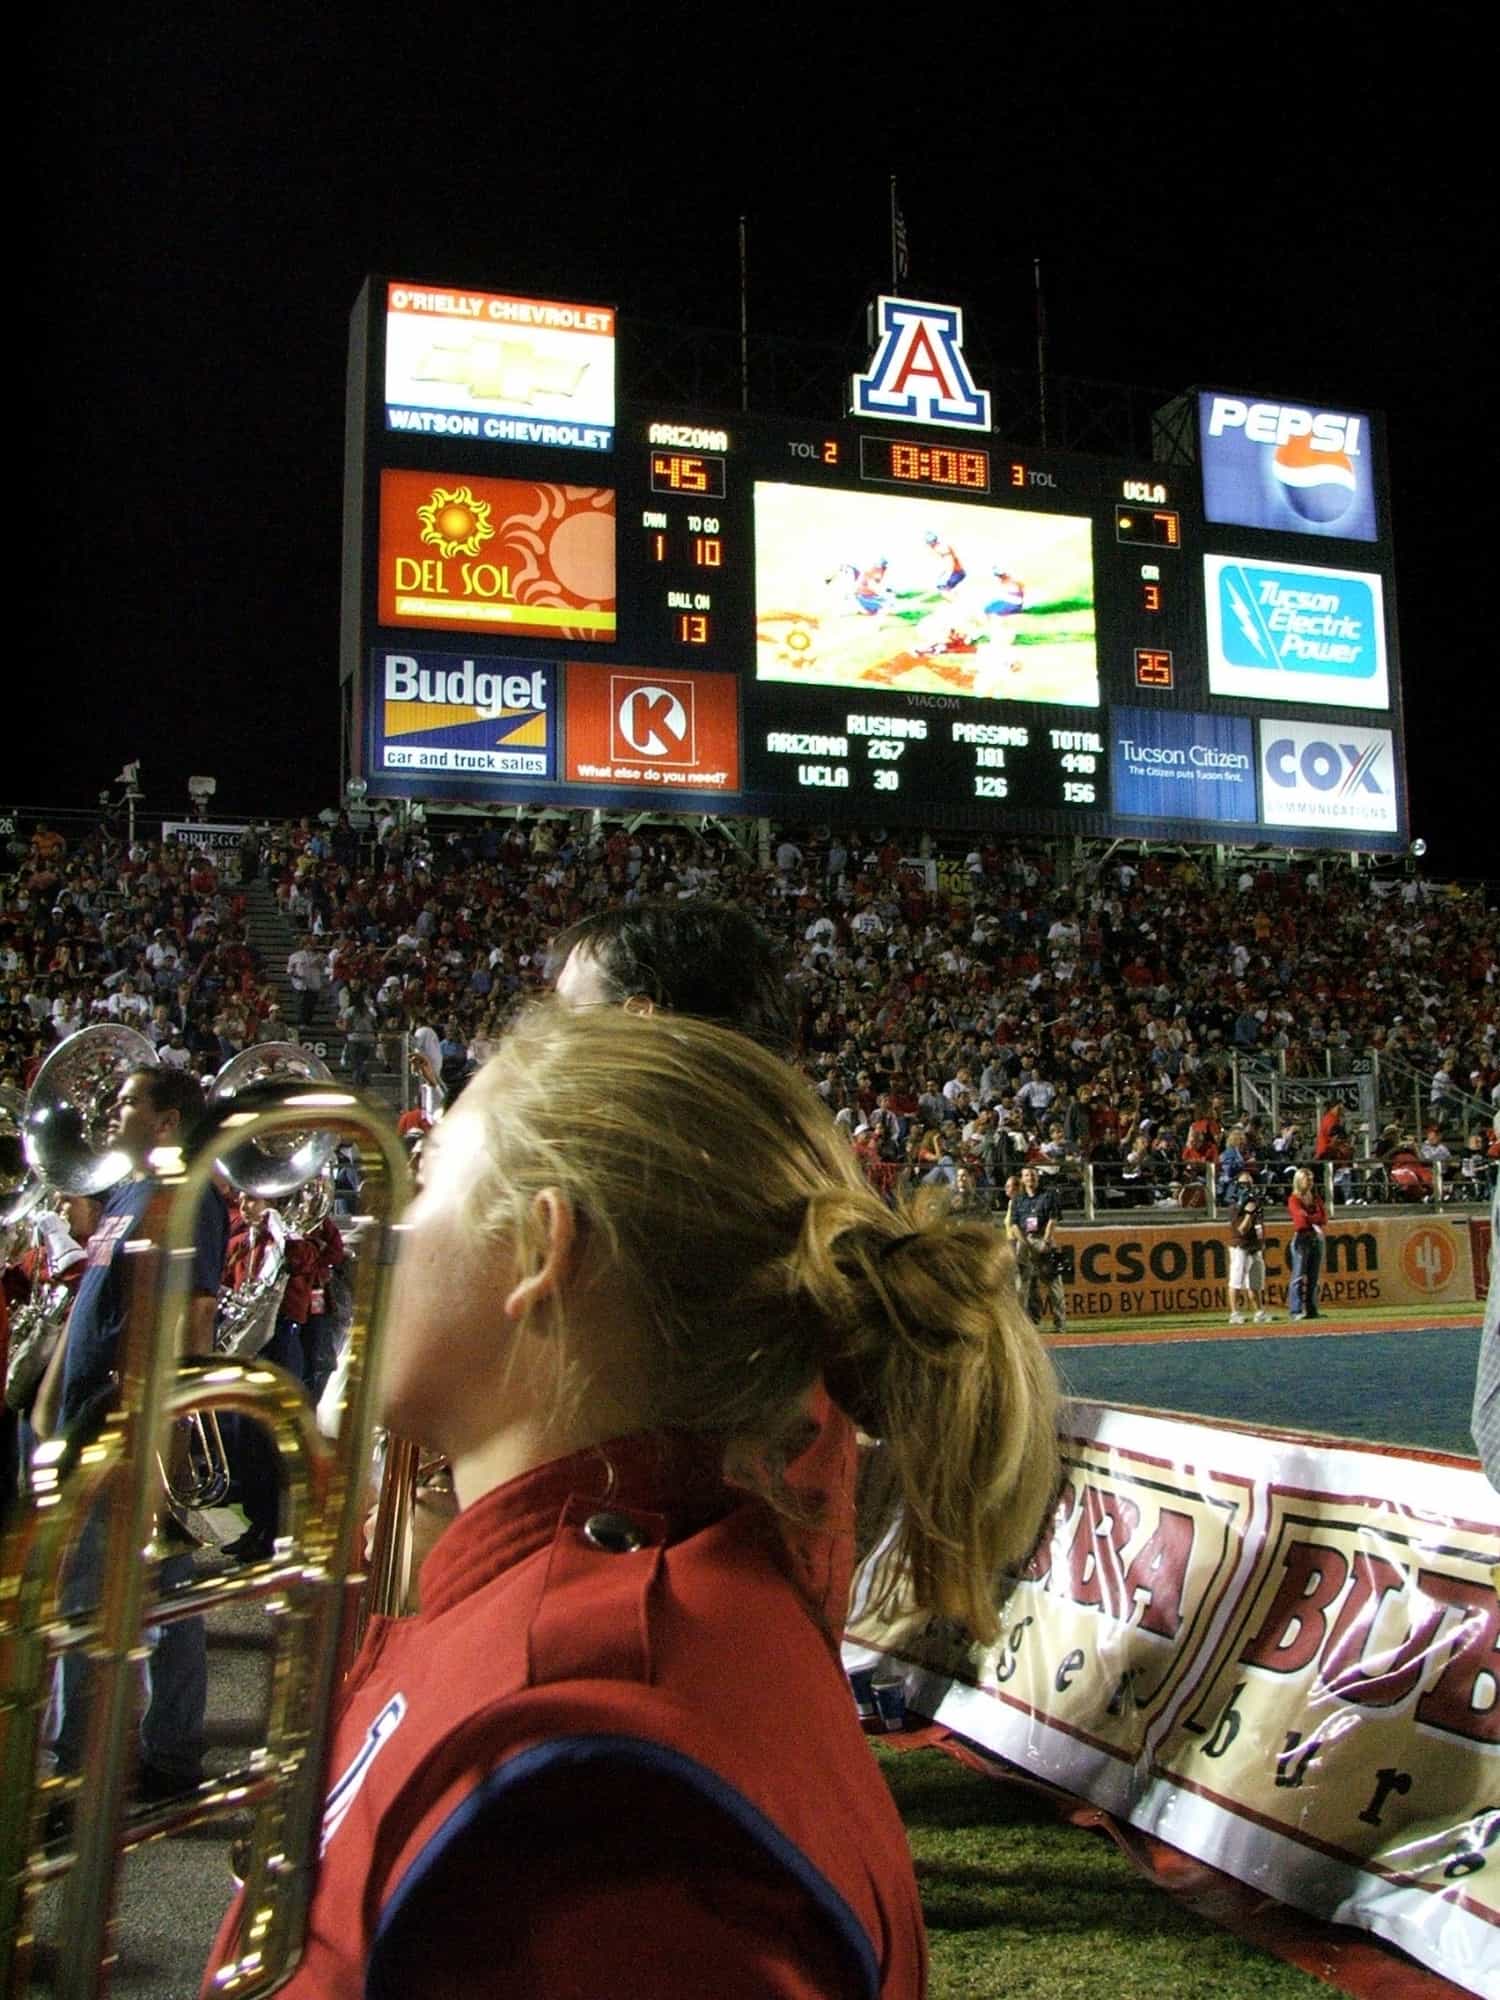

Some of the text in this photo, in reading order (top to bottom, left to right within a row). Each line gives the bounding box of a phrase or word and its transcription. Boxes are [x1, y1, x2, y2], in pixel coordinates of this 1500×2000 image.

[391, 289, 612, 332] O'RIELLY CHEVROLET
[853, 295, 992, 432] A
[388, 409, 611, 450] WATSON CHEVROLET
[648, 422, 729, 453] ARIZONA
[1208, 397, 1361, 456] PEPSI
[788, 441, 838, 464] TOL 2
[654, 457, 707, 491] 45
[1012, 465, 1057, 488] 3 TOL
[1122, 480, 1167, 505] UCLA
[687, 515, 720, 535] TO GO
[1153, 512, 1177, 543] 7
[656, 534, 664, 561] 1
[696, 538, 721, 567] 10
[395, 557, 514, 599] DEL SOL
[667, 591, 693, 609] BALL
[1144, 586, 1159, 611] 3
[1258, 580, 1340, 614] Tucson
[681, 615, 707, 643] 13
[1267, 606, 1362, 641] Electric
[1279, 632, 1364, 665] Power
[1138, 652, 1170, 685] 25
[384, 654, 547, 721] Budget
[905, 695, 961, 710] VIACOM
[766, 732, 848, 758] ARIZONA
[867, 739, 905, 762] 267
[847, 714, 1104, 753] RUSHING PASSING TOTAL
[387, 751, 544, 772] car and truck sales
[1118, 739, 1249, 769] Tucson Citizen
[1264, 737, 1387, 798] COX
[577, 764, 612, 778] What
[614, 767, 641, 780] else
[643, 768, 661, 781] do
[662, 771, 686, 784] you
[798, 765, 849, 789] UCLA
[872, 769, 899, 792] 30
[974, 776, 1008, 799] 126
[1128, 765, 1146, 775] The
[1176, 769, 1195, 780] puts
[1196, 770, 1224, 781] Tucson
[1266, 800, 1388, 819] MMUNICATIONS
[303, 1041, 328, 1058] 26
[1120, 1291, 1145, 1313] BY
